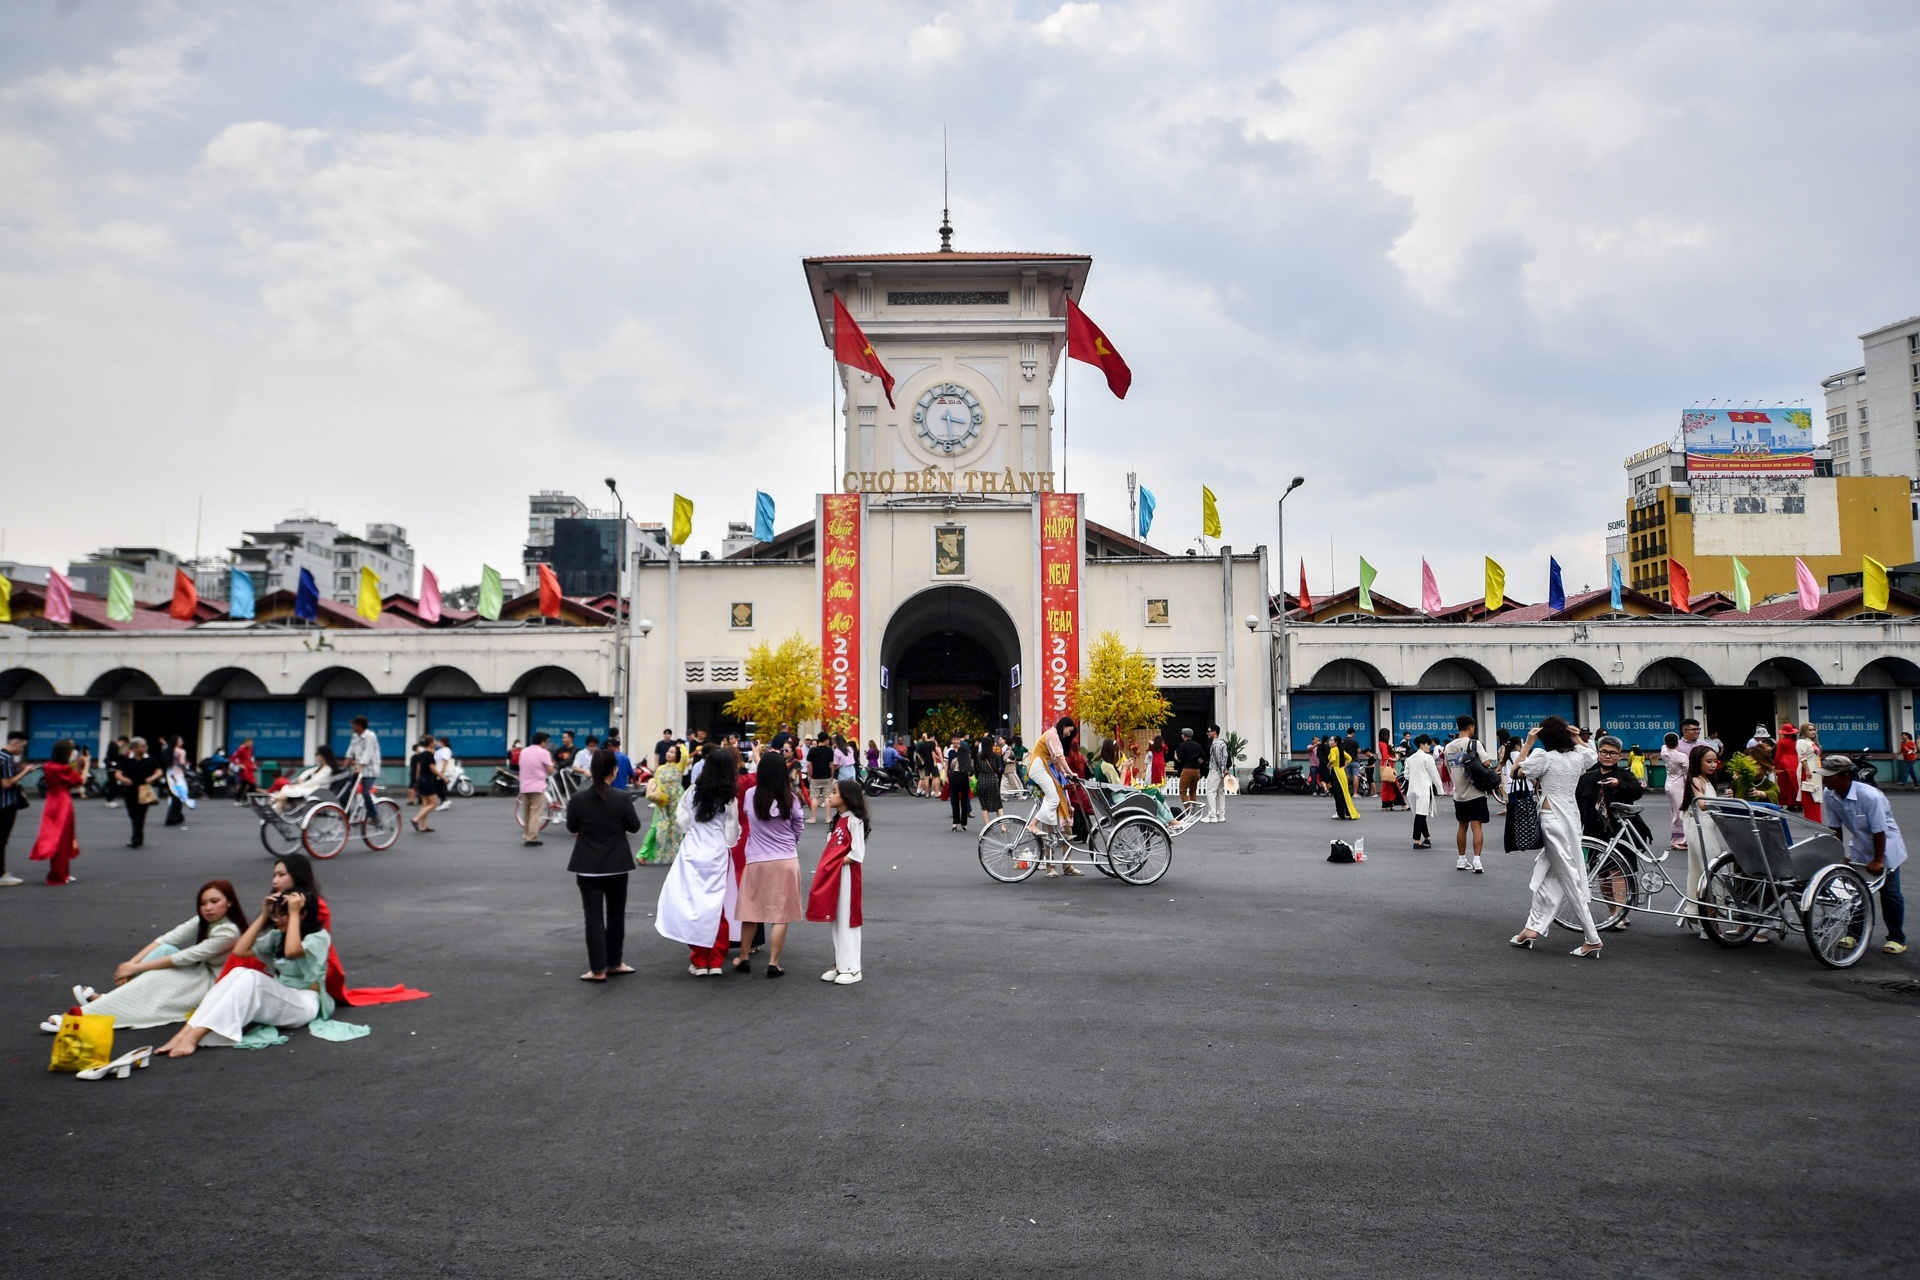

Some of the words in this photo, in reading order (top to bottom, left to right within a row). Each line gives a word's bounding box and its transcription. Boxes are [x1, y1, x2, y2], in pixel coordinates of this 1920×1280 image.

[942, 383, 957, 396] 12
[943, 441, 953, 453] 6
[1732, 443, 1771, 455] 2023
[843, 468, 895, 496] CHỢ
[903, 465, 953, 493] BẾN
[962, 466, 1056, 493] THÀNH
[828, 518, 854, 538] Chúc
[1043, 517, 1075, 539] HAPPY
[1608, 519, 1626, 530] SONG
[824, 546, 857, 570] Mừng
[1048, 563, 1071, 585] NEW
[1047, 610, 1073, 634] YEAR
[832, 638, 849, 711] 2023
[1050, 638, 1067, 711] 2023
[1297, 722, 1365, 731] 0969.39.8989
[1606, 721, 1675, 730] 0969.39.89.89
